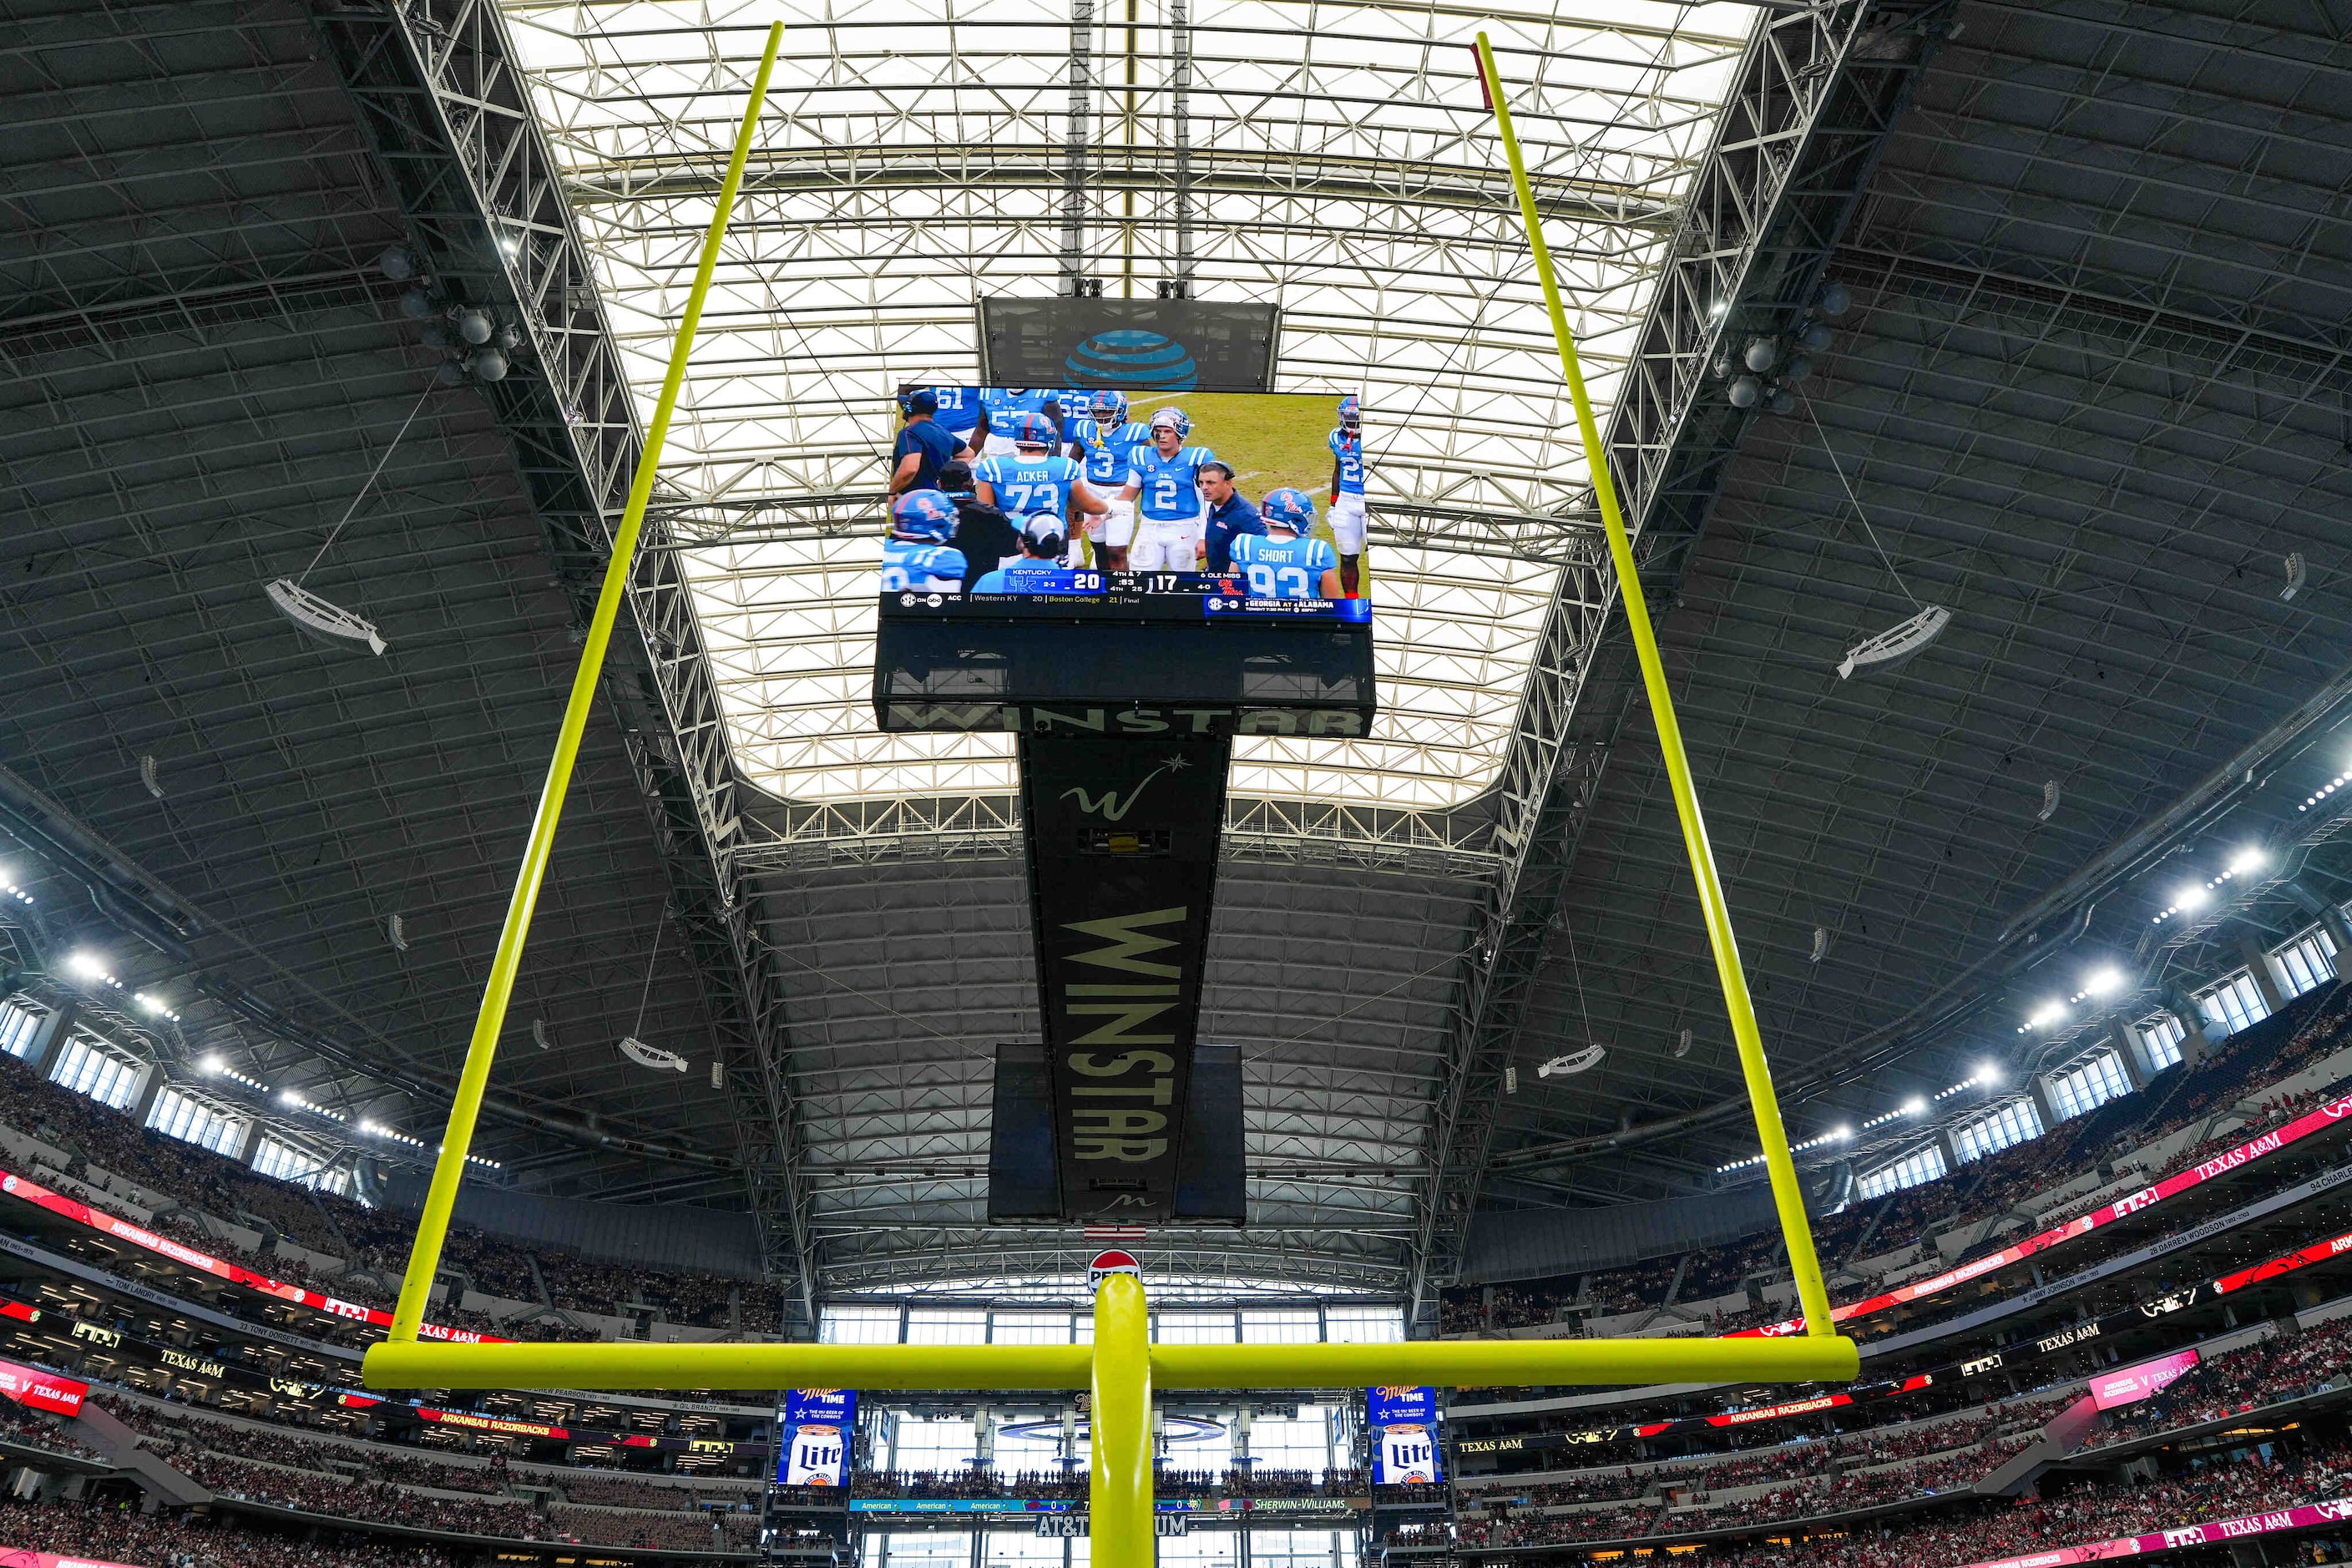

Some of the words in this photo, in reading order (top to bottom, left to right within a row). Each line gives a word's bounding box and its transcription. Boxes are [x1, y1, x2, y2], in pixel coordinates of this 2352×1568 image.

[1094, 452, 1114, 478] 3
[1016, 470, 1048, 483] ACKER
[1004, 483, 1060, 518] 73
[1155, 479, 1177, 510] 2
[1258, 548, 1294, 564] SHORT
[1074, 574, 1100, 589] 20
[1156, 574, 1177, 590] 17
[1247, 564, 1310, 599] 93
[1075, 595, 1100, 604] College
[888, 703, 1363, 736] WINSTAR
[1059, 905, 1188, 1162] WINSTAR
[2194, 1147, 2246, 1181] TEXAS
[2248, 1130, 2284, 1159] A&M
[2309, 1181, 2321, 1192] 94
[110, 1221, 159, 1248] ARKANSAS
[2150, 1247, 2158, 1256] 28
[2159, 1236, 2188, 1253] DARREN
[2188, 1221, 2225, 1241] WOODSON
[1090, 1271, 1138, 1282] PEI
[1914, 1274, 1955, 1296] ARKANSAS
[114, 1279, 130, 1292] TOM
[129, 1285, 155, 1301] LANDRY
[2028, 1288, 2046, 1302] JIMMY
[2046, 1277, 2076, 1295] JOHNSON
[239, 1322, 248, 1331] 33
[250, 1325, 268, 1338] TONY
[268, 1328, 300, 1345] DORSETT
[417, 1323, 449, 1340] EXAS
[453, 1331, 482, 1344] A&M
[2036, 1330, 2075, 1353] TEXAS
[2076, 1323, 2102, 1341] A&M
[160, 1349, 199, 1371] TEXAS
[198, 1362, 225, 1378] A&M
[2140, 1374, 2148, 1387] V
[2151, 1368, 2178, 1383] TEXAS
[21, 1380, 33, 1393] V
[33, 1384, 62, 1401] TEXAS
[554, 1388, 585, 1399] PEARSON
[821, 1394, 846, 1404] TIME
[1399, 1393, 1424, 1403] TIME
[1729, 1408, 1776, 1424] ARKANSAS
[1777, 1398, 1834, 1416] RAZORBACKS
[440, 1413, 488, 1429] ARKANSAS
[490, 1420, 550, 1436] RAZORBACKS
[1391, 1444, 1430, 1469] Lite
[1459, 1440, 1496, 1453] TEXAS
[1499, 1439, 1524, 1450] A&M
[798, 1444, 842, 1471] Lite
[1050, 1501, 1057, 1510] 0
[1176, 1500, 1183, 1510] 0
[1254, 1498, 1346, 1510] SHERWIN-WILLIAMS
[1036, 1515, 1090, 1537] AT&T
[2219, 1515, 2263, 1538] TEXAS
[2263, 1510, 2294, 1529] A&M
